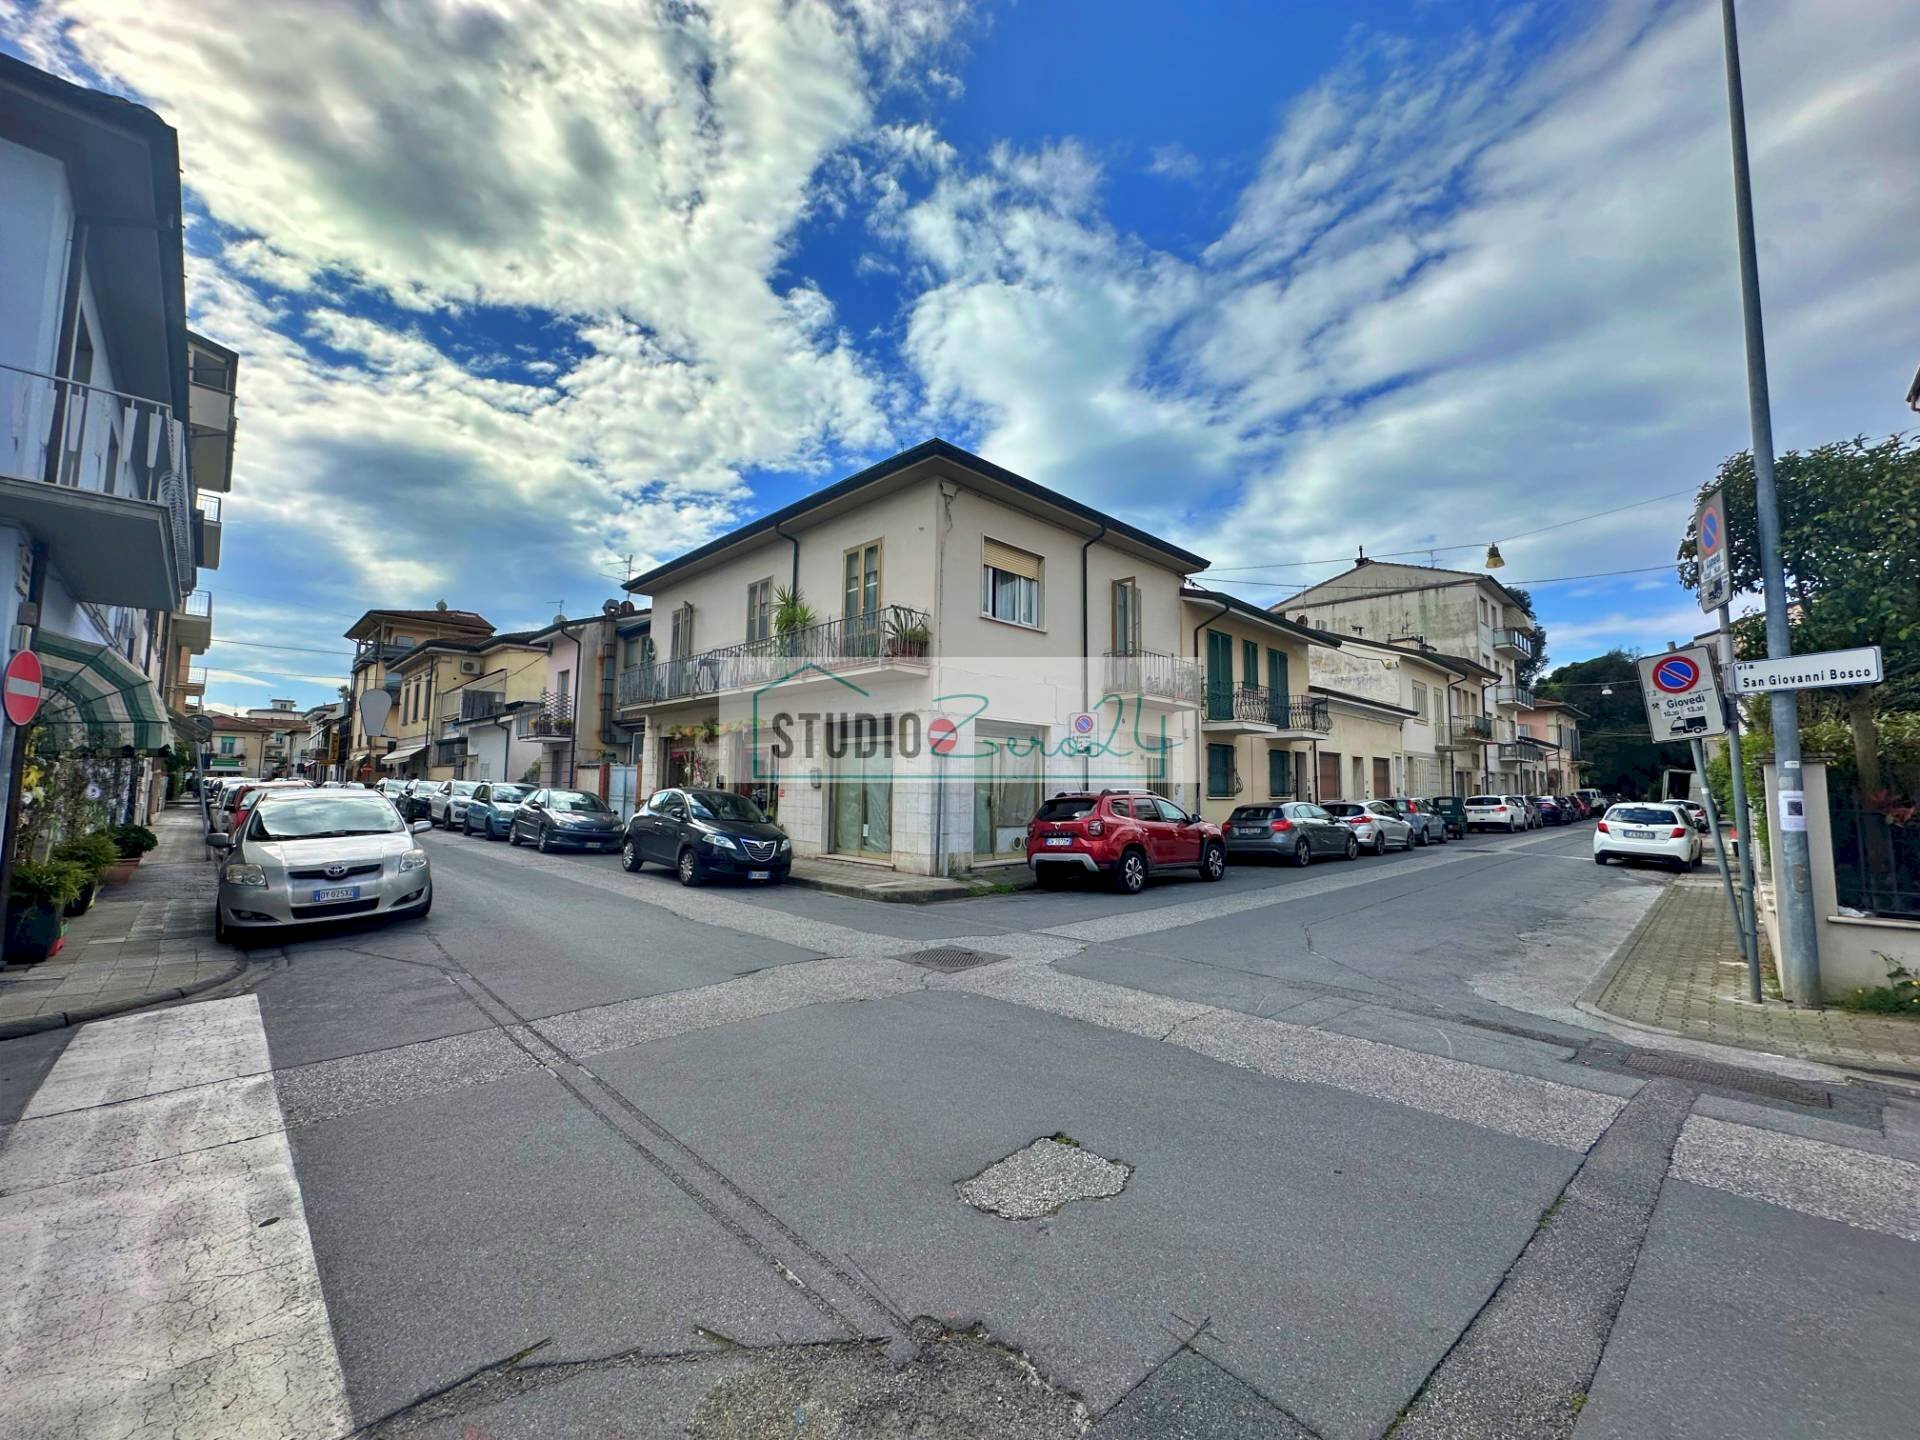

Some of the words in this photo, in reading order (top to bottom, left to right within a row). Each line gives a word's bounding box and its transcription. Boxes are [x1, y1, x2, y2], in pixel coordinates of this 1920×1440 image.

[1743, 677, 1765, 688] San
[1768, 670, 1825, 686] Giovanni
[1830, 667, 1872, 681] Bosco
